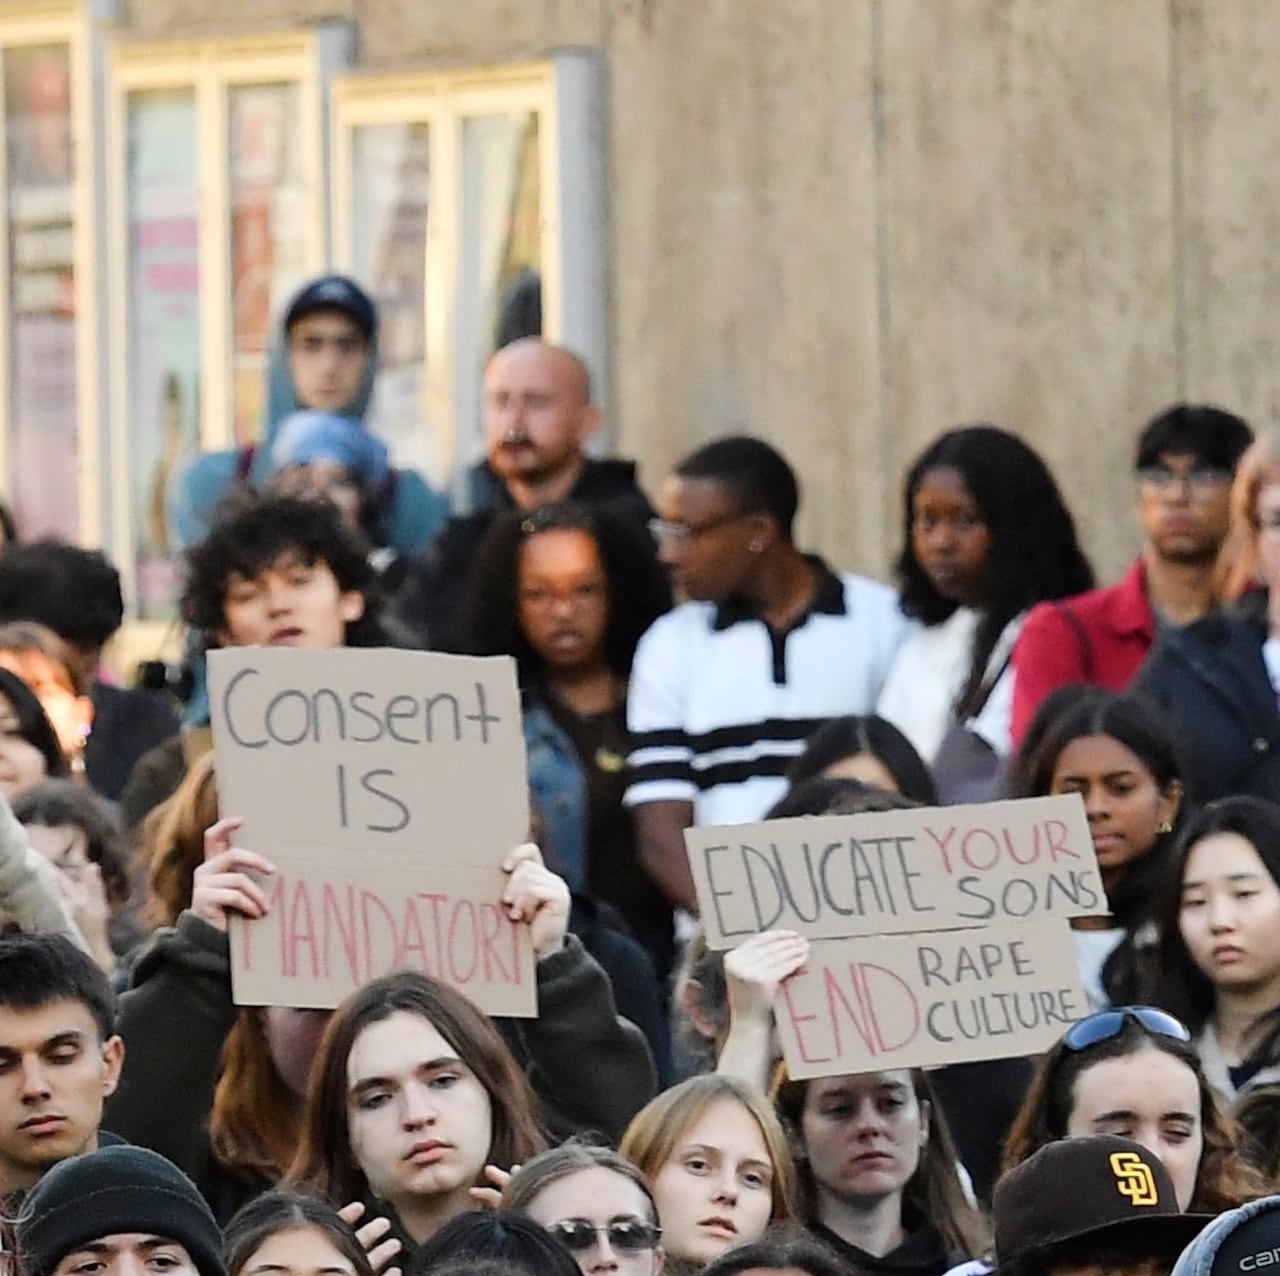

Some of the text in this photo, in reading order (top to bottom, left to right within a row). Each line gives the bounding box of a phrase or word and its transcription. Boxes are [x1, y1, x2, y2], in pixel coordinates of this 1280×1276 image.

[223, 668, 501, 749] Consent
[338, 764, 411, 833] IS
[704, 820, 1081, 938] EDUCATE YOUR
[956, 870, 1099, 919] SONS
[780, 941, 1037, 1065] END RAPE
[925, 988, 1080, 1043] CULTURE
